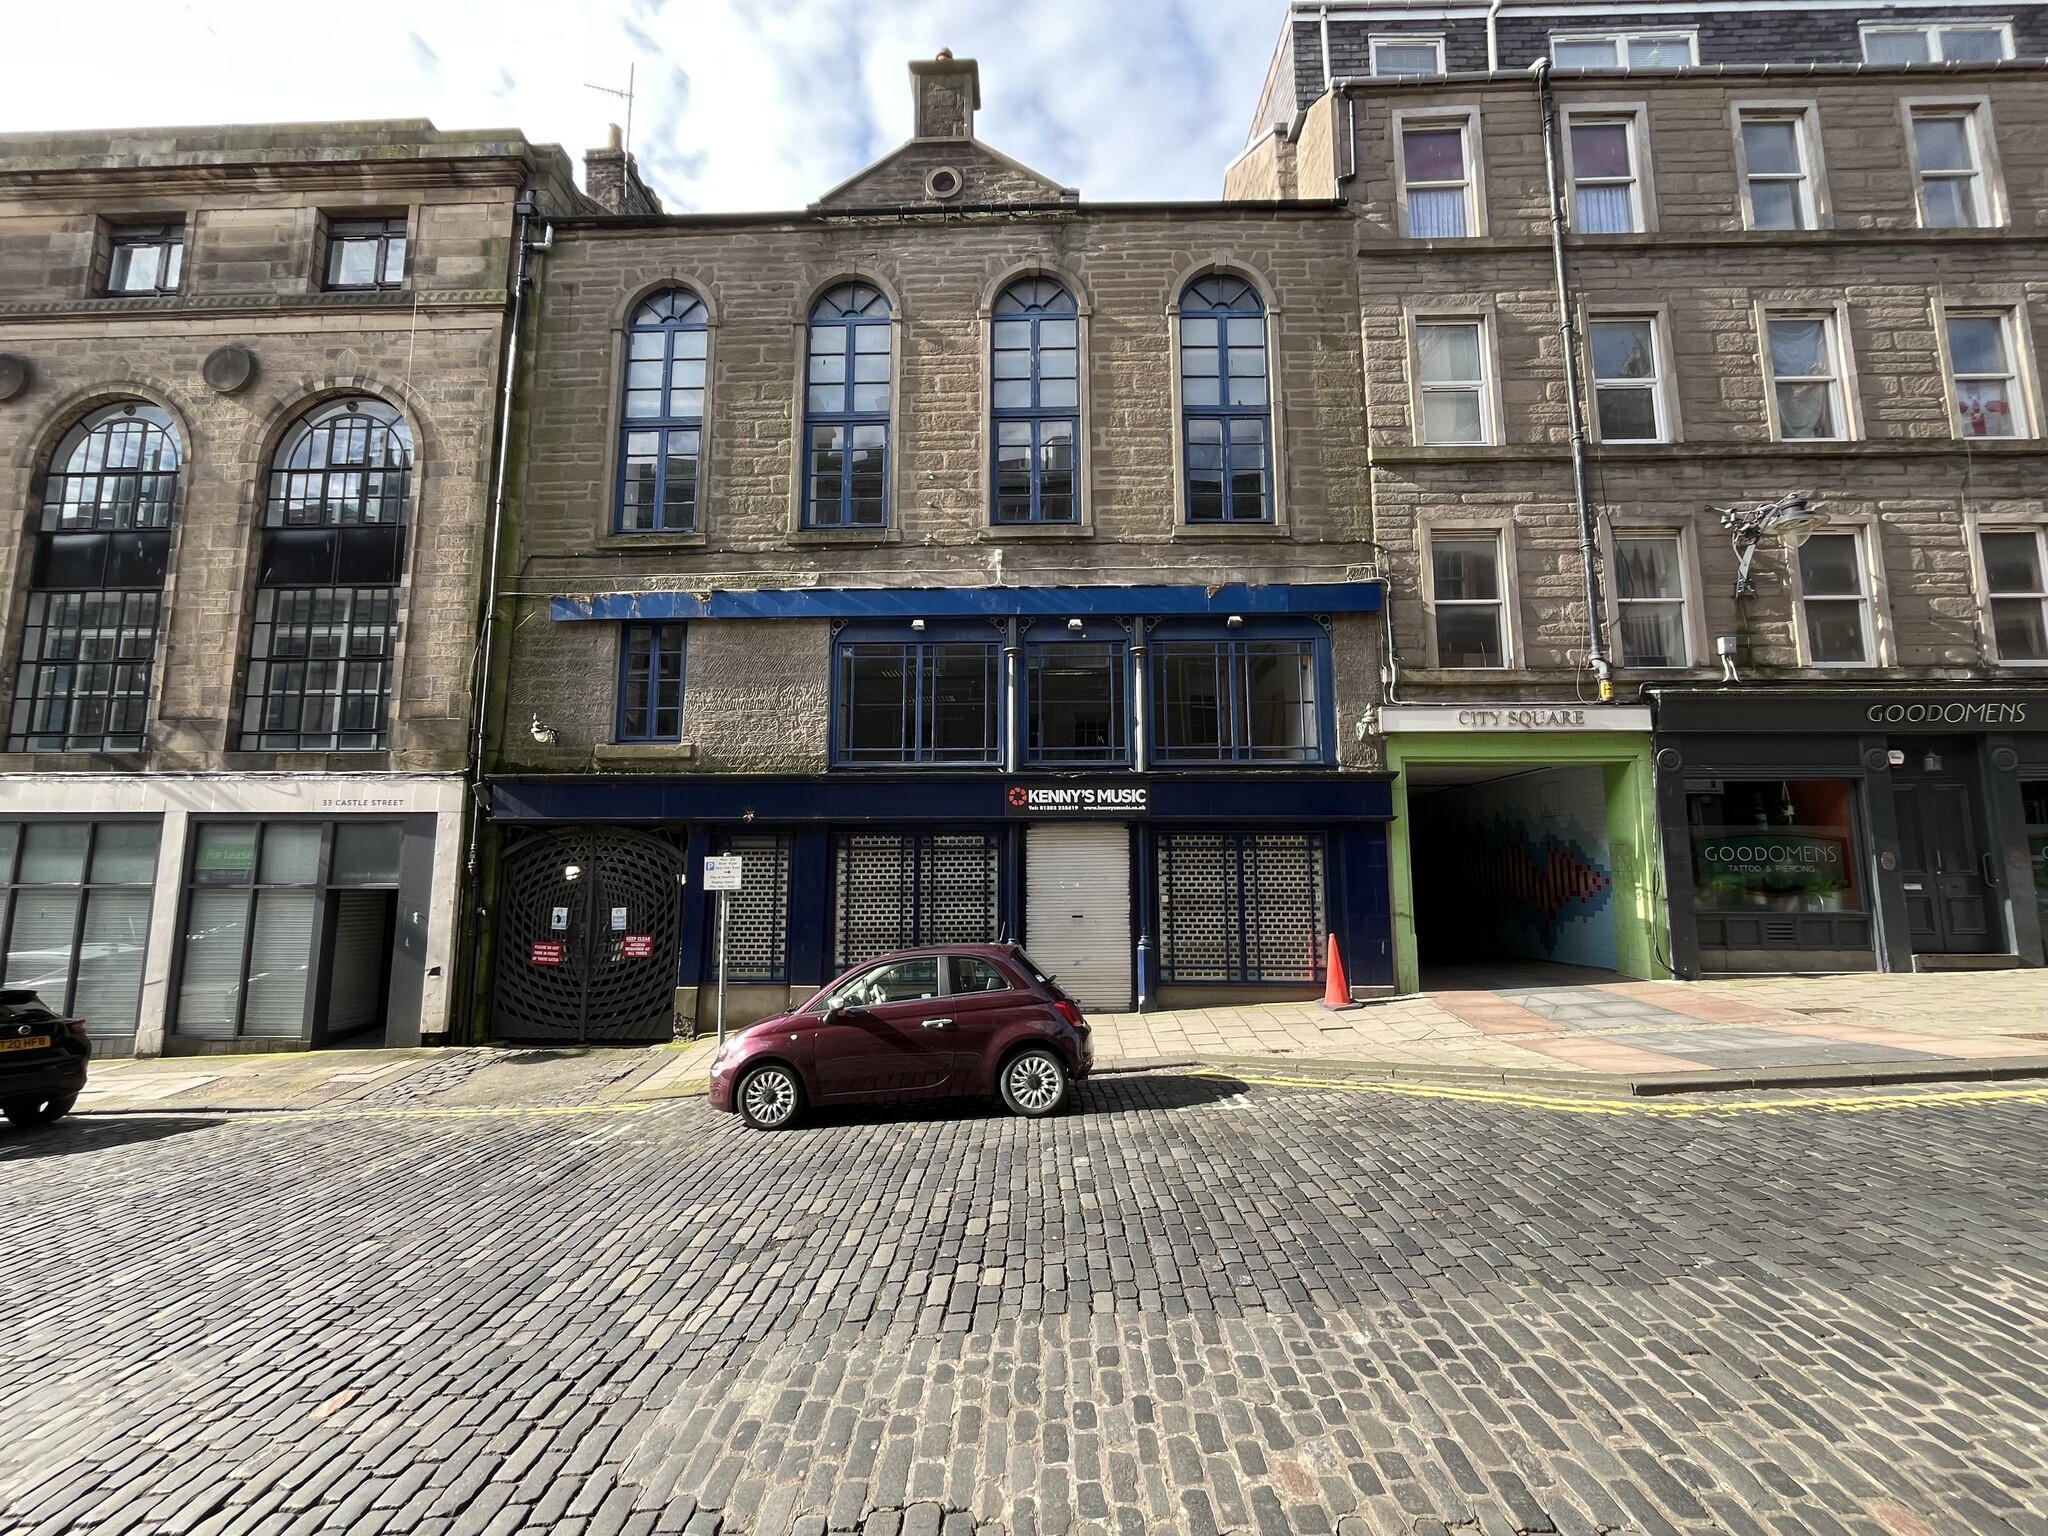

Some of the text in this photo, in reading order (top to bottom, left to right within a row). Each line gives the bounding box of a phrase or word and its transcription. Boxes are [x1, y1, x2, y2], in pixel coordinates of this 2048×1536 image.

[1458, 710, 1584, 727] CITY SQUARE
[1867, 703, 2026, 722] GOODOMENS
[1028, 789, 1146, 803] KENNY'S MUSIC
[206, 849, 252, 859] For Lease
[1705, 846, 1837, 862] GOODOMENS
[1776, 865, 1816, 873] PIERCING
[23, 1037, 45, 1048] HFB
